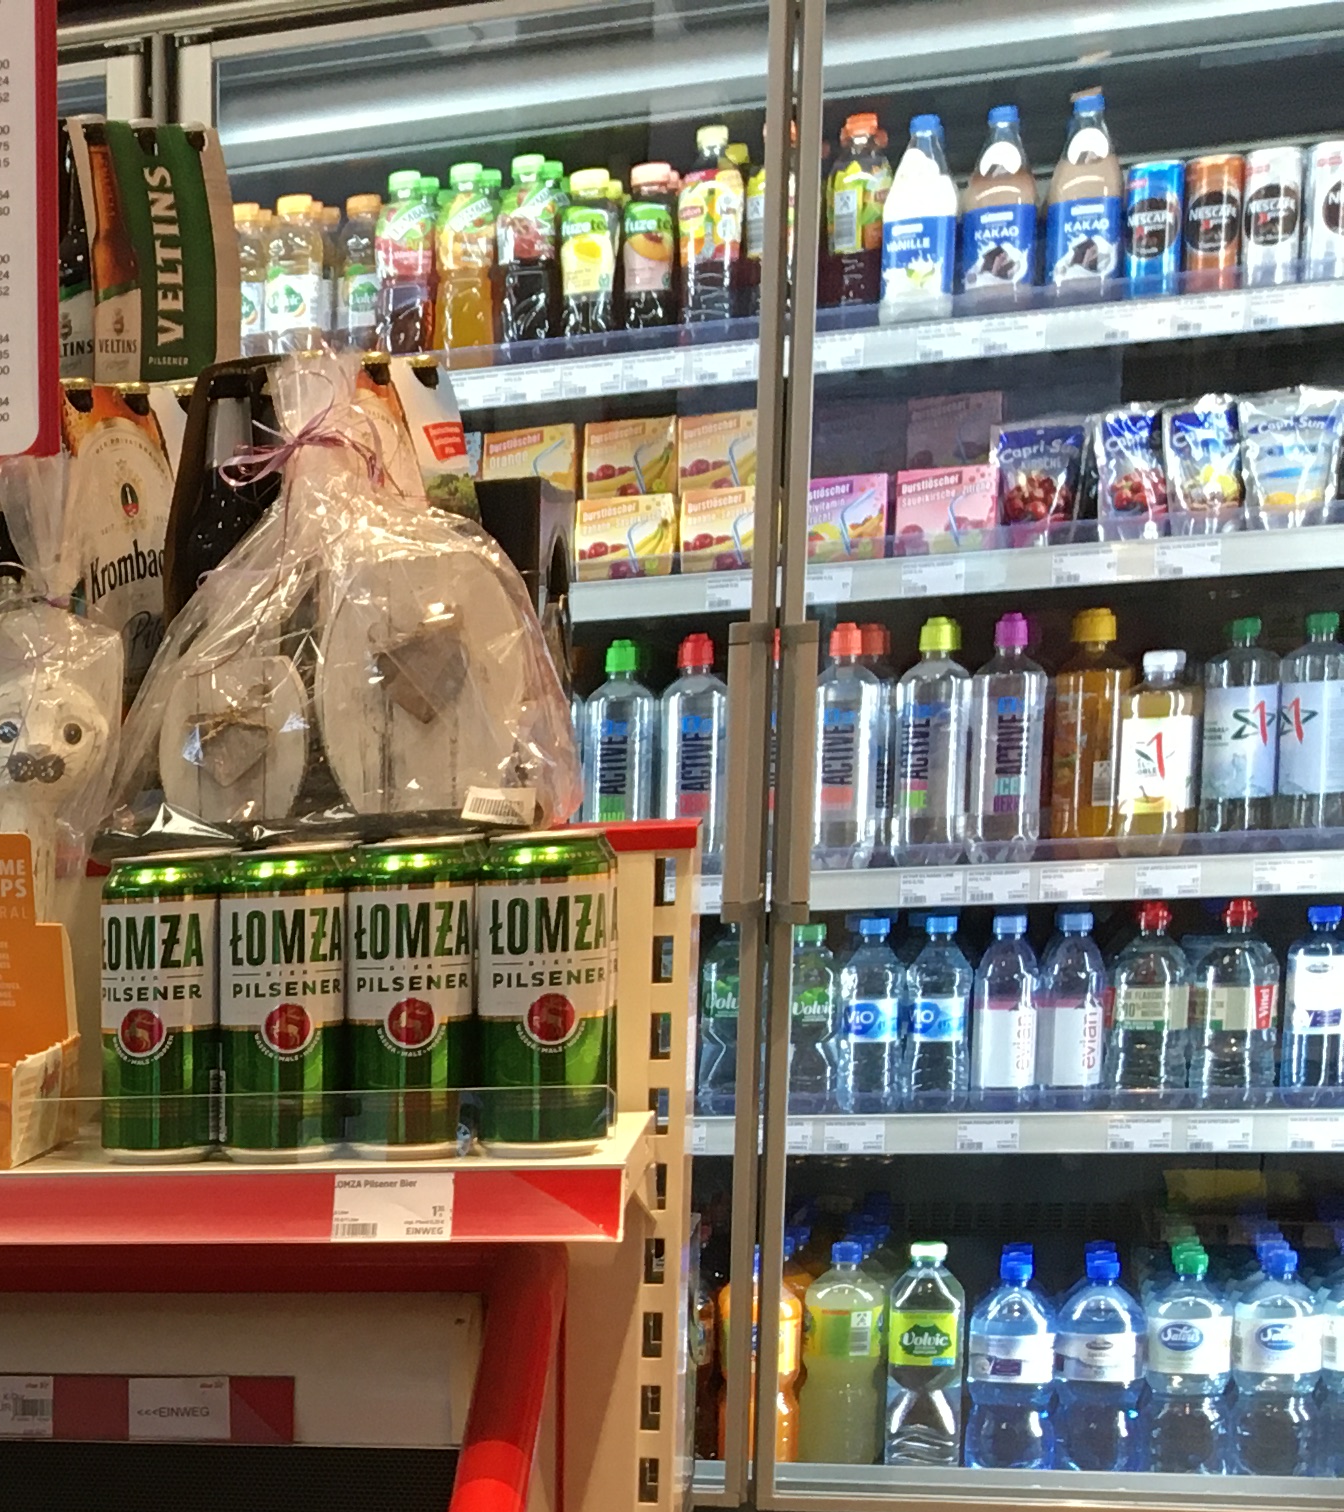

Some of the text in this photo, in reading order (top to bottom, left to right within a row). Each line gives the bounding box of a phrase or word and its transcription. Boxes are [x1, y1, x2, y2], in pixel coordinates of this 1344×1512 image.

[974, 226, 1019, 241] KAKAO
[1064, 218, 1110, 234] KAKAO
[887, 237, 930, 252] VANILLE
[144, 166, 184, 346] VELTINS
[99, 340, 138, 355] VELTINS
[148, 354, 189, 367] PILSENER
[489, 432, 544, 454] Durstlöscher
[901, 474, 960, 495] Durstlöscher
[583, 502, 637, 522] Durstlöscher
[687, 494, 743, 513] Durstlöscher
[356, 973, 468, 993] PILSENER
[492, 967, 606, 989] PILSENER
[232, 978, 341, 999] PILSENER
[792, 1000, 835, 1019] Volvic
[1016, 1011, 1034, 1071] evian
[1083, 1008, 1099, 1070] evian
[364, 1179, 417, 1188] Pilsener Bier
[405, 1226, 443, 1235] EINWEG
[900, 1330, 951, 1352] Volvic
